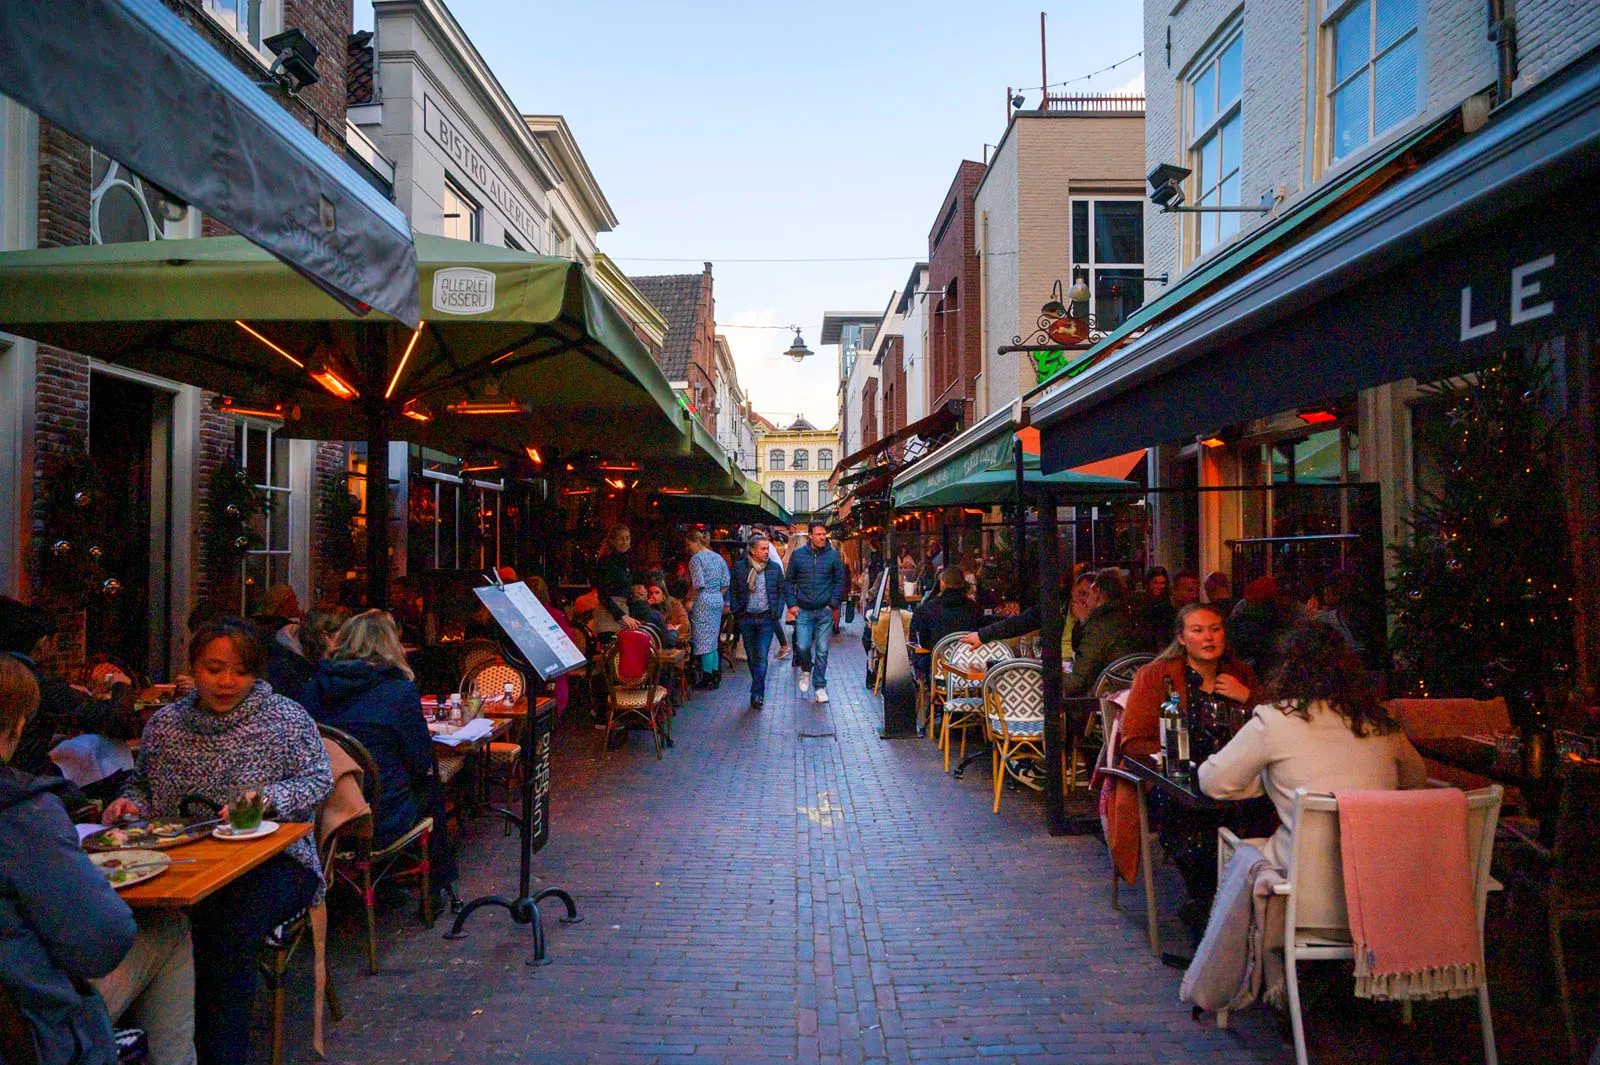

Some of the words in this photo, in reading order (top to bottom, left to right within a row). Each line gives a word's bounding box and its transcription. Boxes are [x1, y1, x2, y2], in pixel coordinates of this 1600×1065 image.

[439, 118, 487, 186] BISTRO
[489, 178, 535, 241] ALLERLEI
[441, 278, 488, 293] ALLERLEI
[441, 292, 488, 307] VISSERIJ
[1459, 253, 1556, 342] LE
[541, 731, 551, 797] DINER
[534, 763, 543, 838] LUNCH
